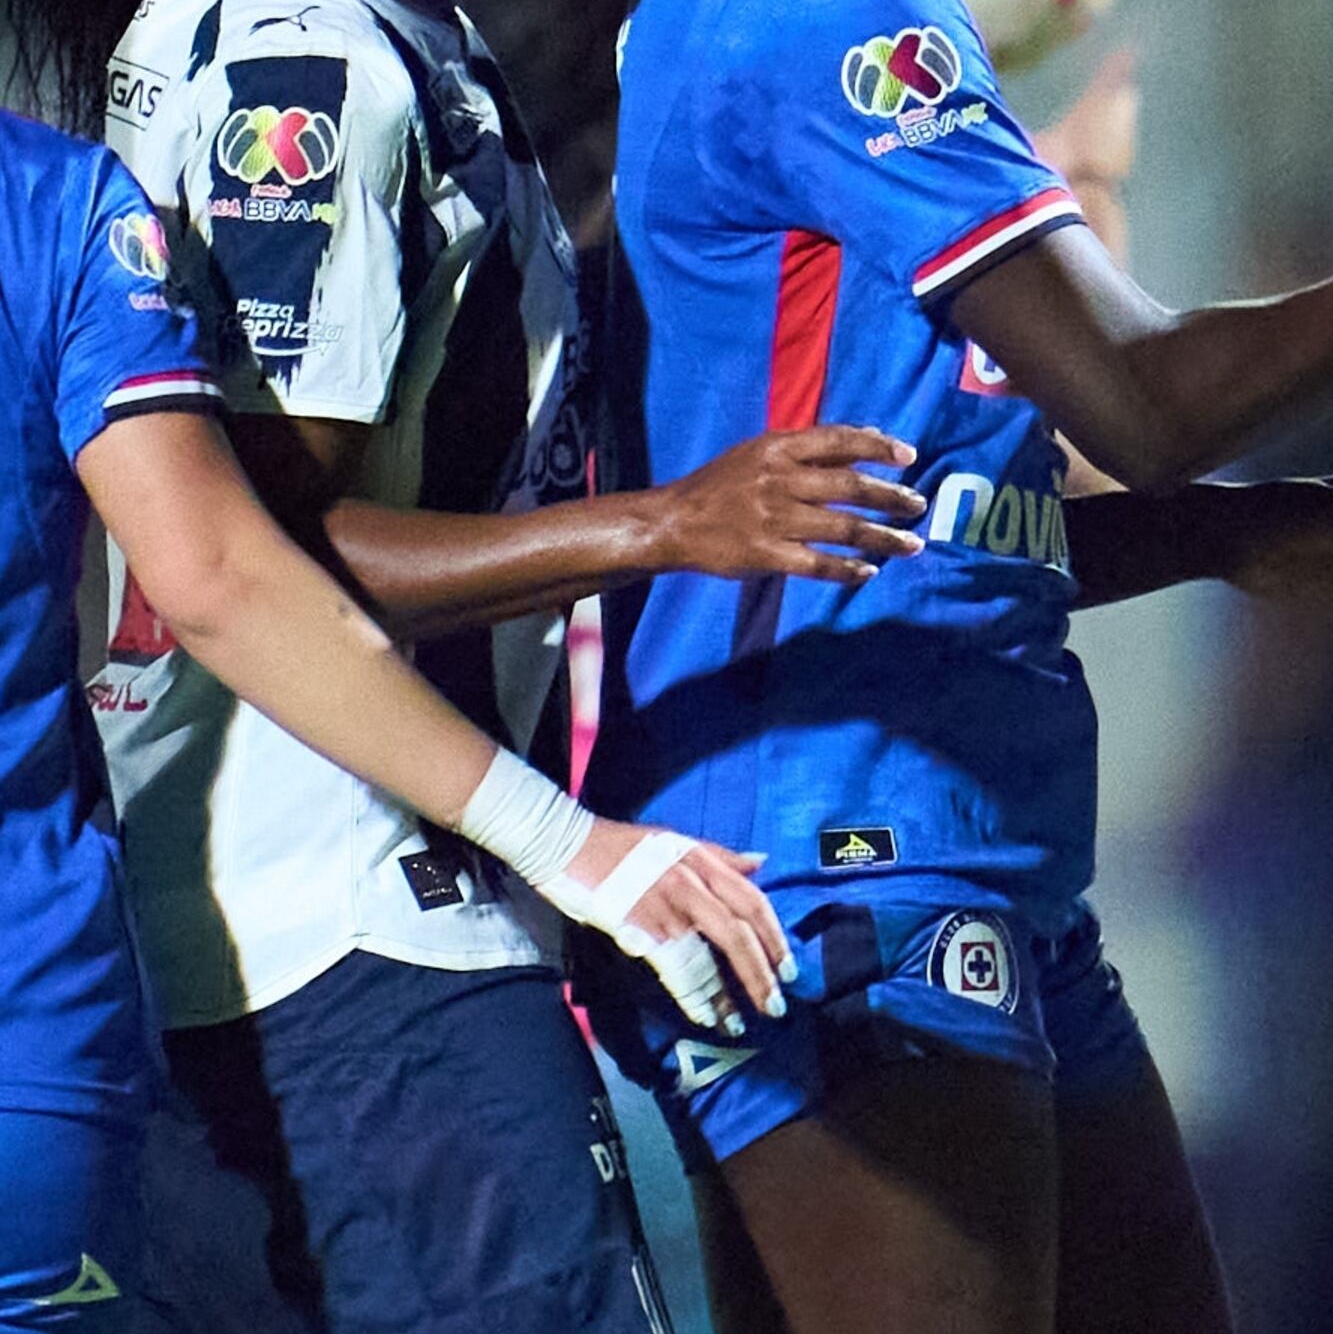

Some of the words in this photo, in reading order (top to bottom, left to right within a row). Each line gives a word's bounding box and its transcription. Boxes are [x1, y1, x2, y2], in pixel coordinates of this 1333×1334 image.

[901, 110, 963, 147] BBVA
[244, 198, 311, 222] BBVA
[236, 298, 295, 319] Pizza
